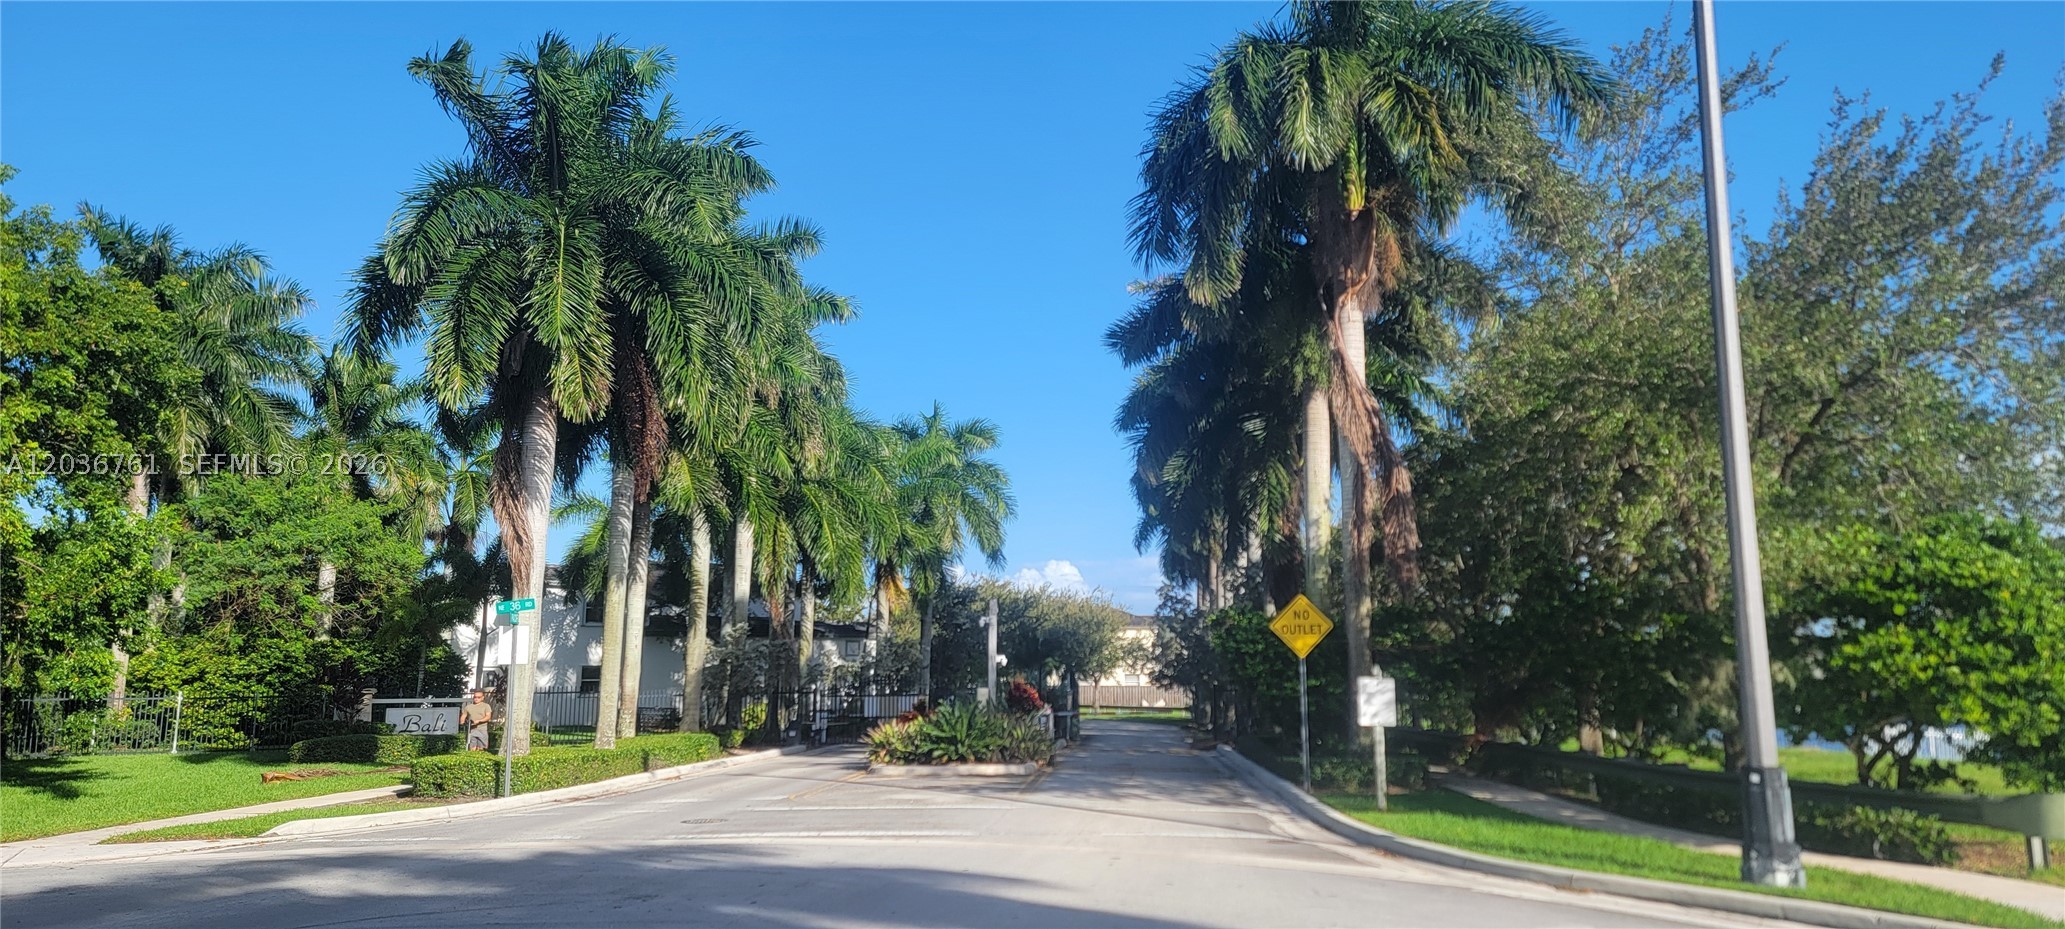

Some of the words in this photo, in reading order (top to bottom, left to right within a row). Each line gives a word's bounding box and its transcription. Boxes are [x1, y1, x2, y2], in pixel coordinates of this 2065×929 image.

[509, 601, 521, 611] 36
[1294, 610, 1310, 620] NO
[1282, 625, 1322, 635] OUTLET
[399, 713, 446, 733] Bali
